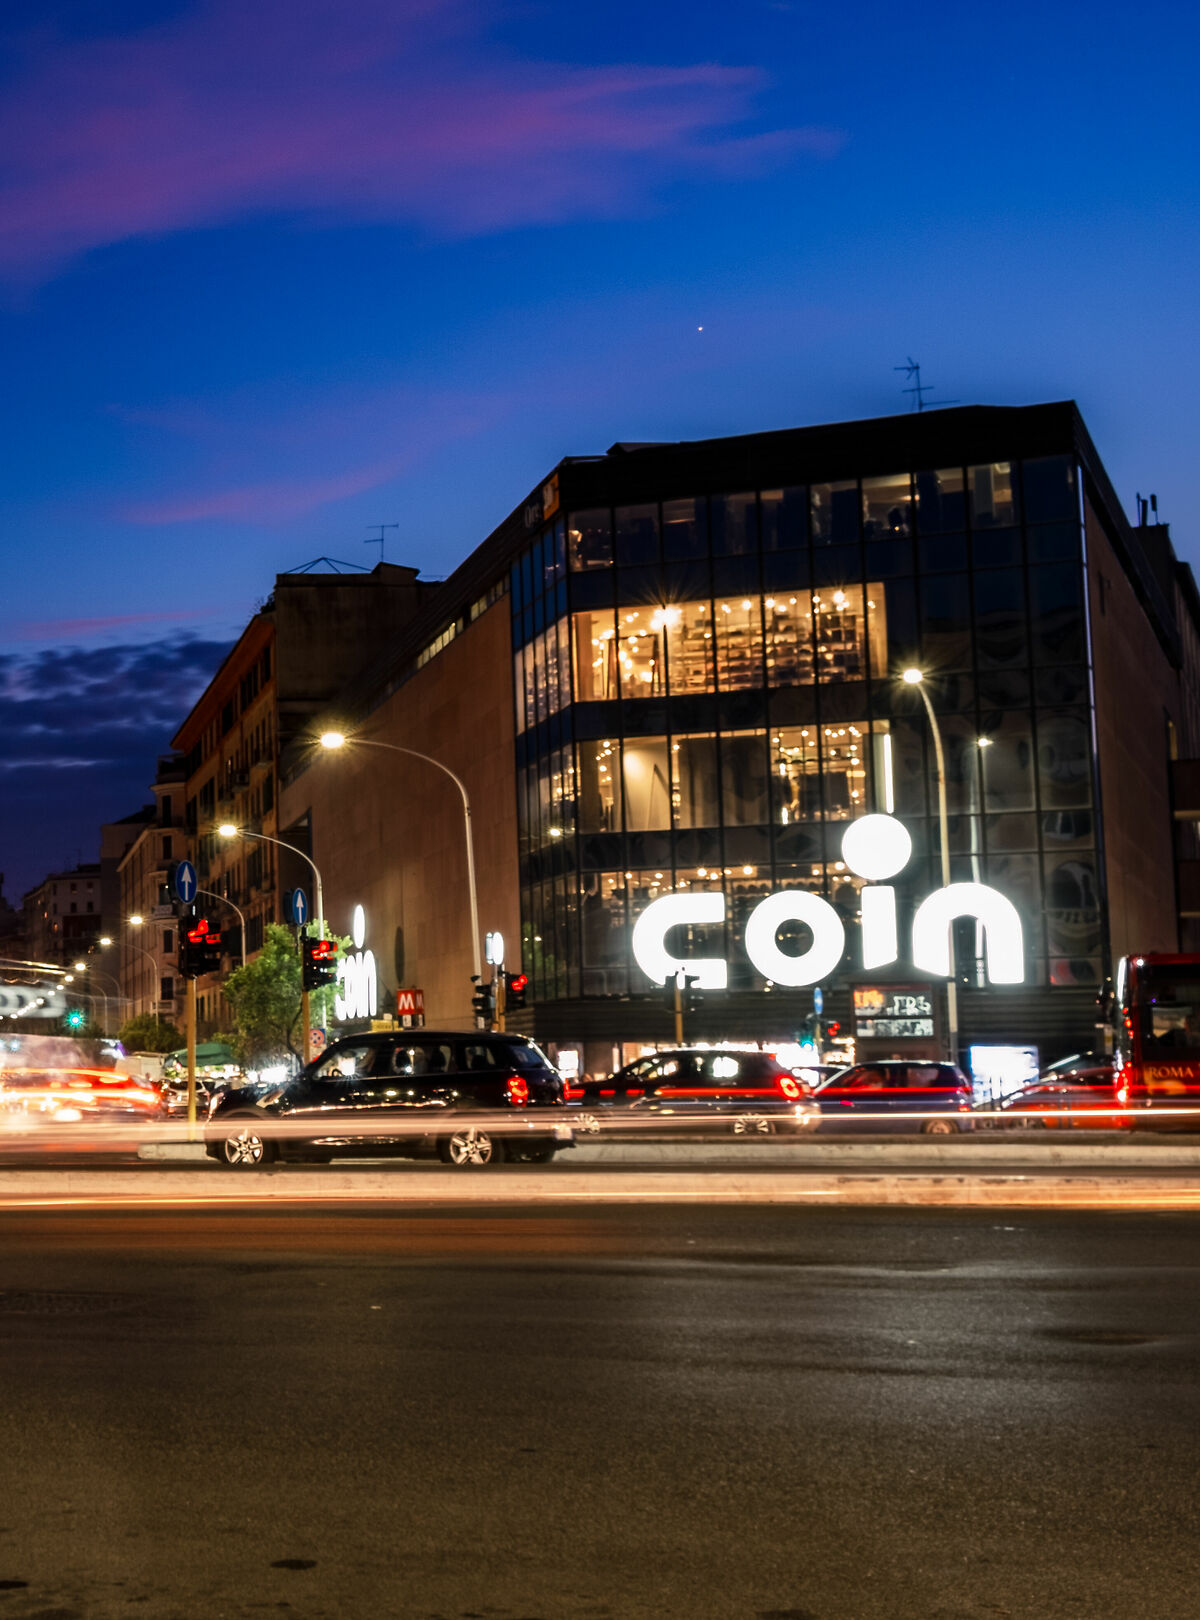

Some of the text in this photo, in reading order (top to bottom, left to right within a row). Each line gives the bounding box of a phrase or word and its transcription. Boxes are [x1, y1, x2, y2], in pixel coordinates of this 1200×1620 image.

[633, 813, 1025, 989] coin
[399, 993, 415, 1010] M
[1148, 1066, 1194, 1078] ROMA
